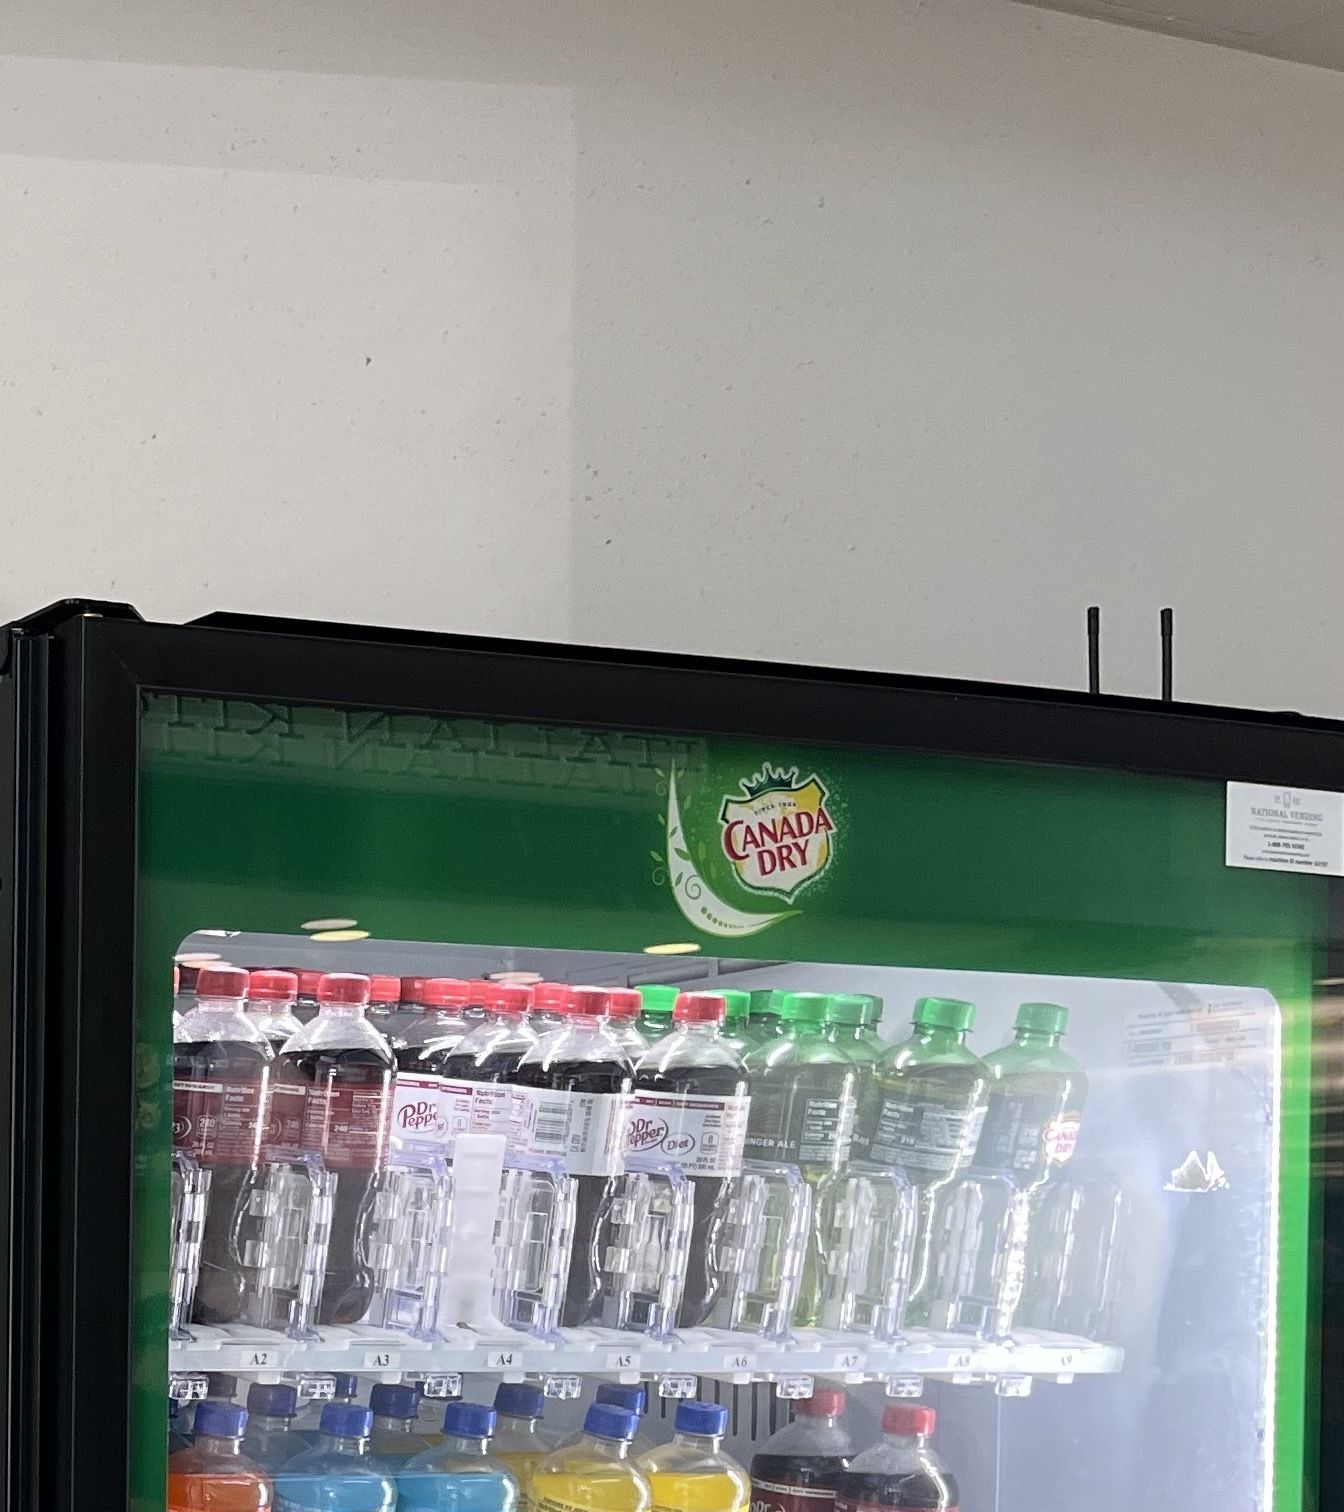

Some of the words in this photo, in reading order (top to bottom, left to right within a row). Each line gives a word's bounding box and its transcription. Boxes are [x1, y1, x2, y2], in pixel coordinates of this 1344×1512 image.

[1250, 807, 1289, 819] NATIONAL
[723, 807, 833, 861] CANADA
[756, 839, 810, 876] DRY
[415, 1101, 437, 1114] Dr
[635, 1117, 652, 1132] Dr
[667, 1138, 689, 1151] Diet
[777, 1139, 796, 1149] ALE
[250, 1352, 268, 1366] A2
[372, 1353, 390, 1367] A3
[495, 1352, 513, 1366] A4
[615, 1354, 632, 1368] A5
[732, 1355, 748, 1369] A6
[841, 1354, 858, 1369] A7
[954, 1355, 971, 1369] A8
